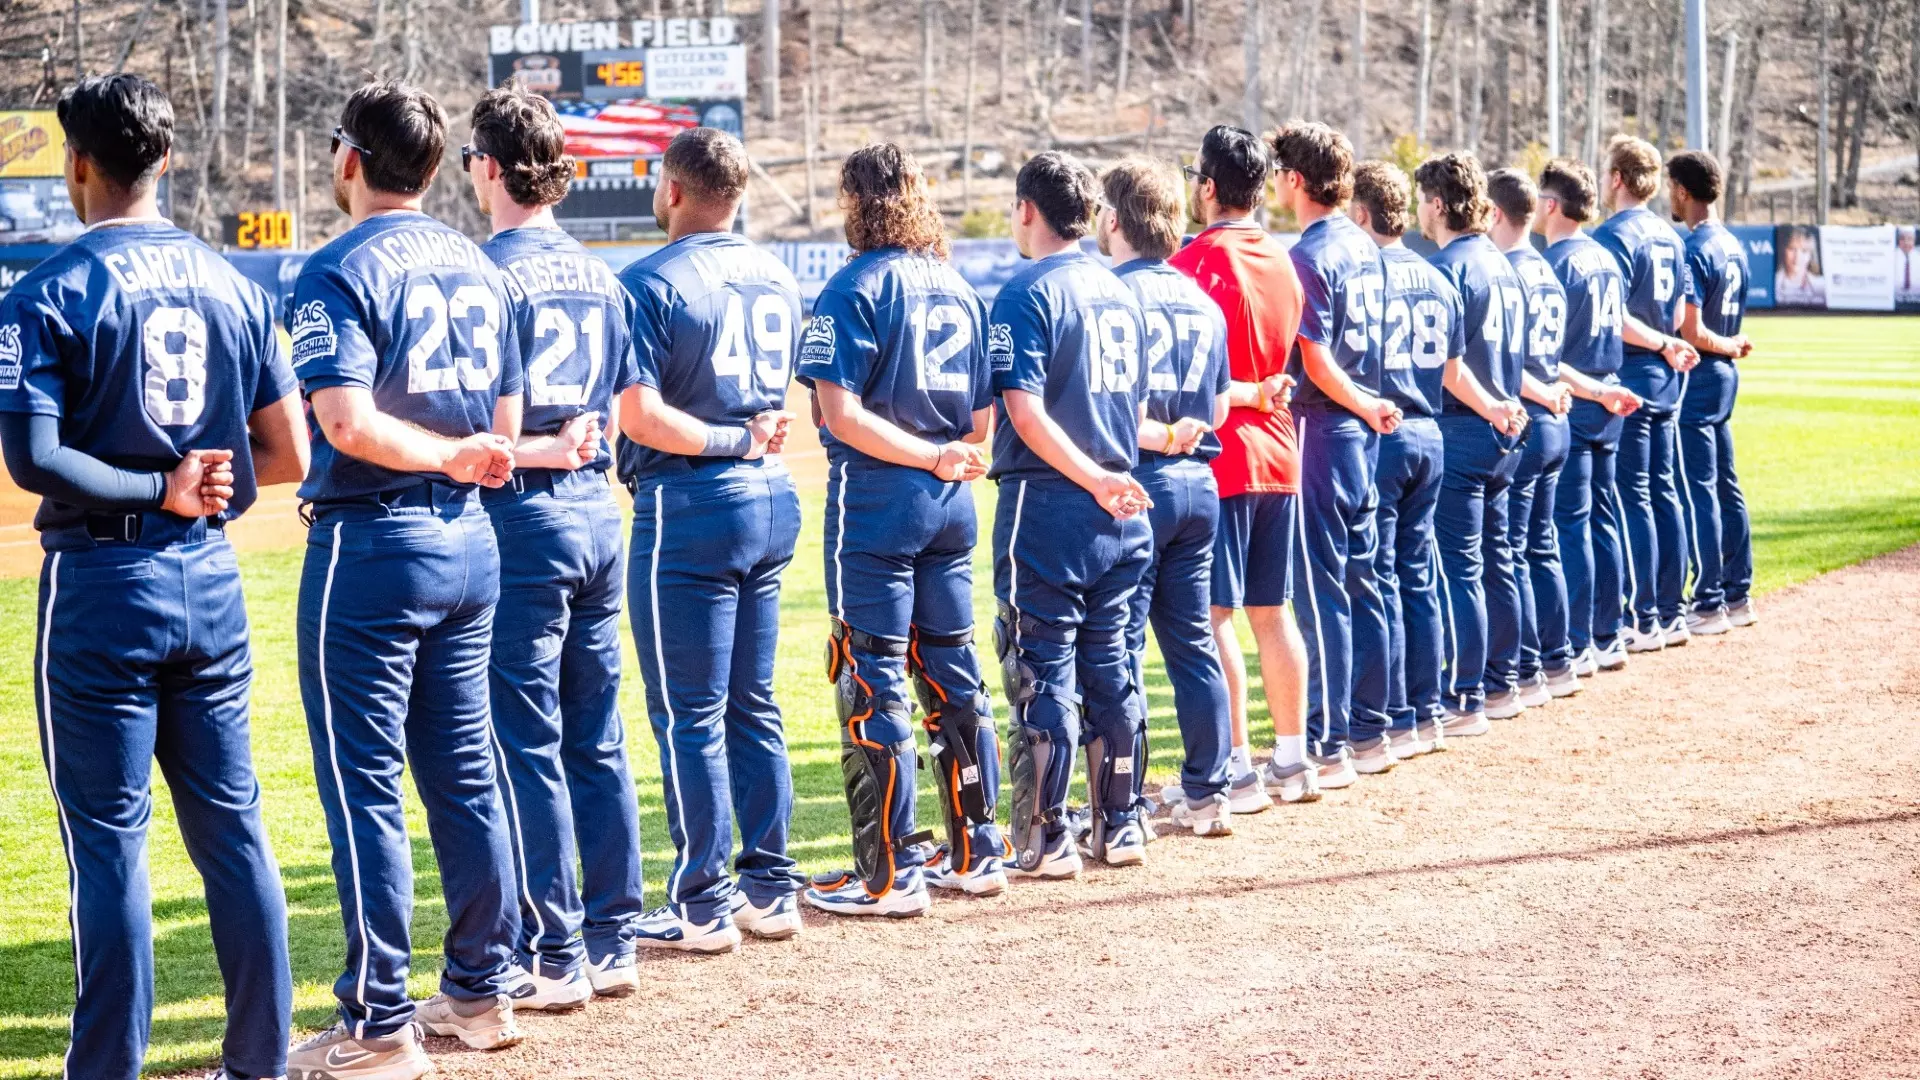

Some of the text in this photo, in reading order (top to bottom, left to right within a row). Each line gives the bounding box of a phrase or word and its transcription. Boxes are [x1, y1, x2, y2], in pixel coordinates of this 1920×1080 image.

[489, 17, 736, 54] BOWEN FIELD
[238, 211, 292, 248] 2:00
[1749, 239, 1774, 256] VA
[104, 245, 215, 294] GARCIA
[1720, 261, 1742, 317] 2
[407, 284, 500, 394] 23
[710, 293, 793, 391] 49
[1385, 300, 1448, 369] 28
[1482, 284, 1525, 353] 47
[1528, 293, 1567, 356] 29
[1587, 277, 1624, 338] 14
[143, 307, 207, 426] 8
[528, 307, 603, 406] 21
[910, 303, 972, 392] 12
[1084, 307, 1140, 393] 18
[1145, 311, 1214, 393] 27
